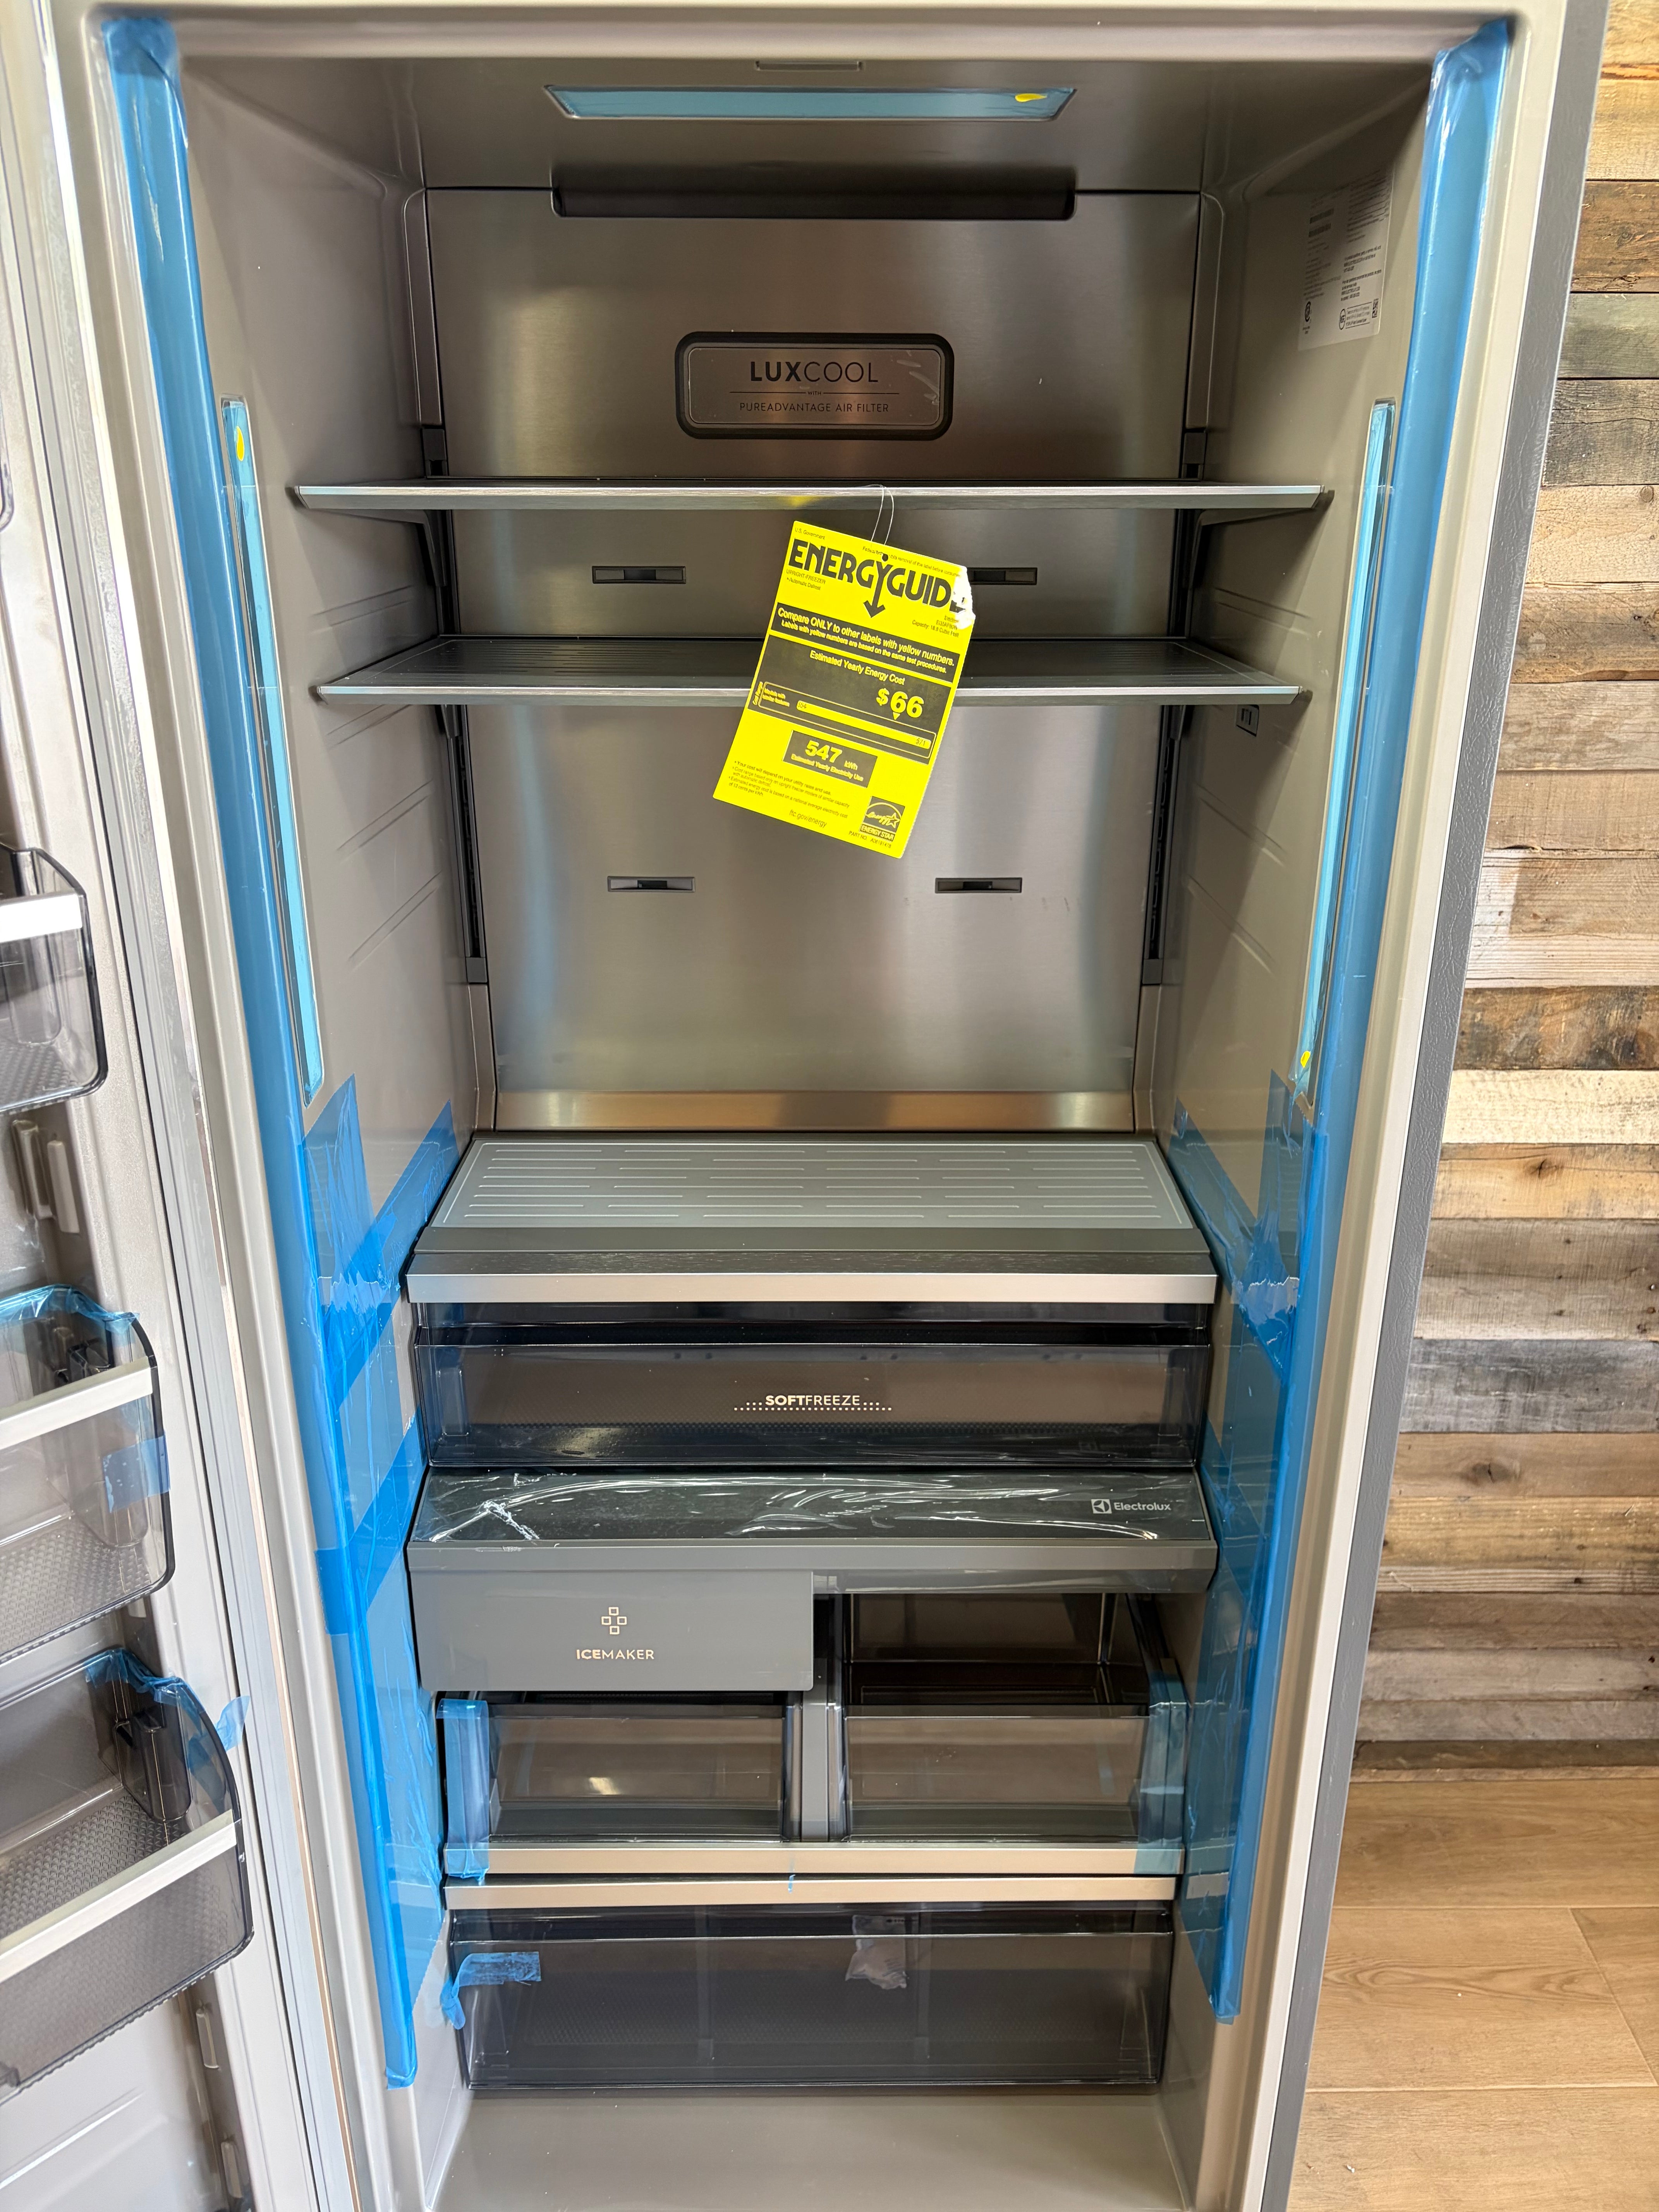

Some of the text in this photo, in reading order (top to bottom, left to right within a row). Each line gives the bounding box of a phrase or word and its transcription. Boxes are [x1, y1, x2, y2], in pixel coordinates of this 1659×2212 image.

[750, 361, 878, 383] LUXCOOL
[740, 402, 889, 412] PUREADVANTAGE AIR FILTER
[778, 608, 954, 666] Compare ONLY to other labels with yellow numbers.
[781, 620, 798, 630] Labels
[809, 629, 826, 638] yellow
[826, 634, 848, 645] numbers
[858, 642, 874, 652] based
[891, 653, 906, 661] same
[906, 656, 917, 665] test
[916, 660, 946, 673] procedures.
[810, 650, 905, 685] Estimated Yearly Energy Cost
[805, 740, 842, 763] 547
[789, 809, 827, 828] ftc.gov/energy
[861, 825, 894, 840] ENERGY STAR
[765, 1395, 860, 1406] SOFTFREEZE
[1114, 1502, 1172, 1511] Electrolux
[576, 1649, 654, 1660] ICEMAKER
